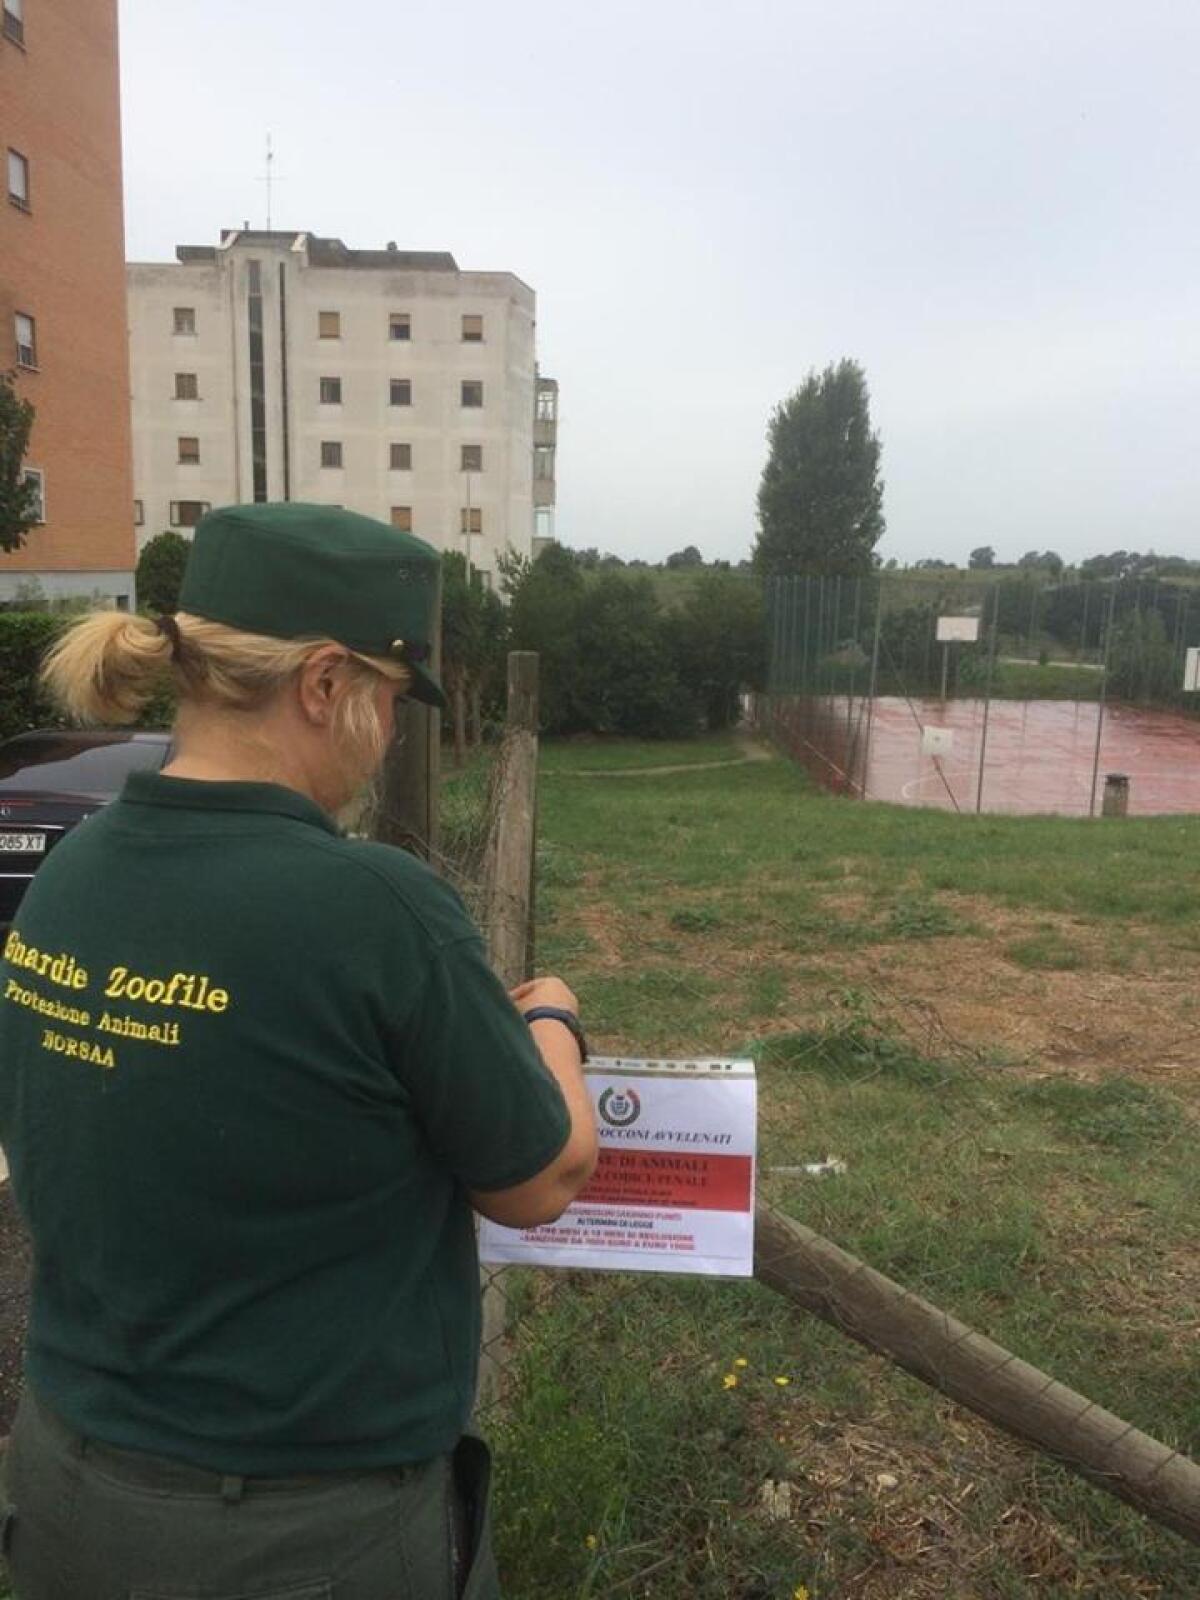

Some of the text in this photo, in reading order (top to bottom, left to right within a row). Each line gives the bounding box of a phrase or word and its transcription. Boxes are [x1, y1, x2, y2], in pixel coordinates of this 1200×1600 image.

[26, 836, 42, 850] XT
[4, 930, 229, 1012] Guardie Zoofile
[4, 979, 181, 1045] Protezione Animali
[42, 1029, 115, 1068] NORSAA
[598, 1128, 649, 1140] OCCONI
[642, 1158, 709, 1171] ANIMALI
